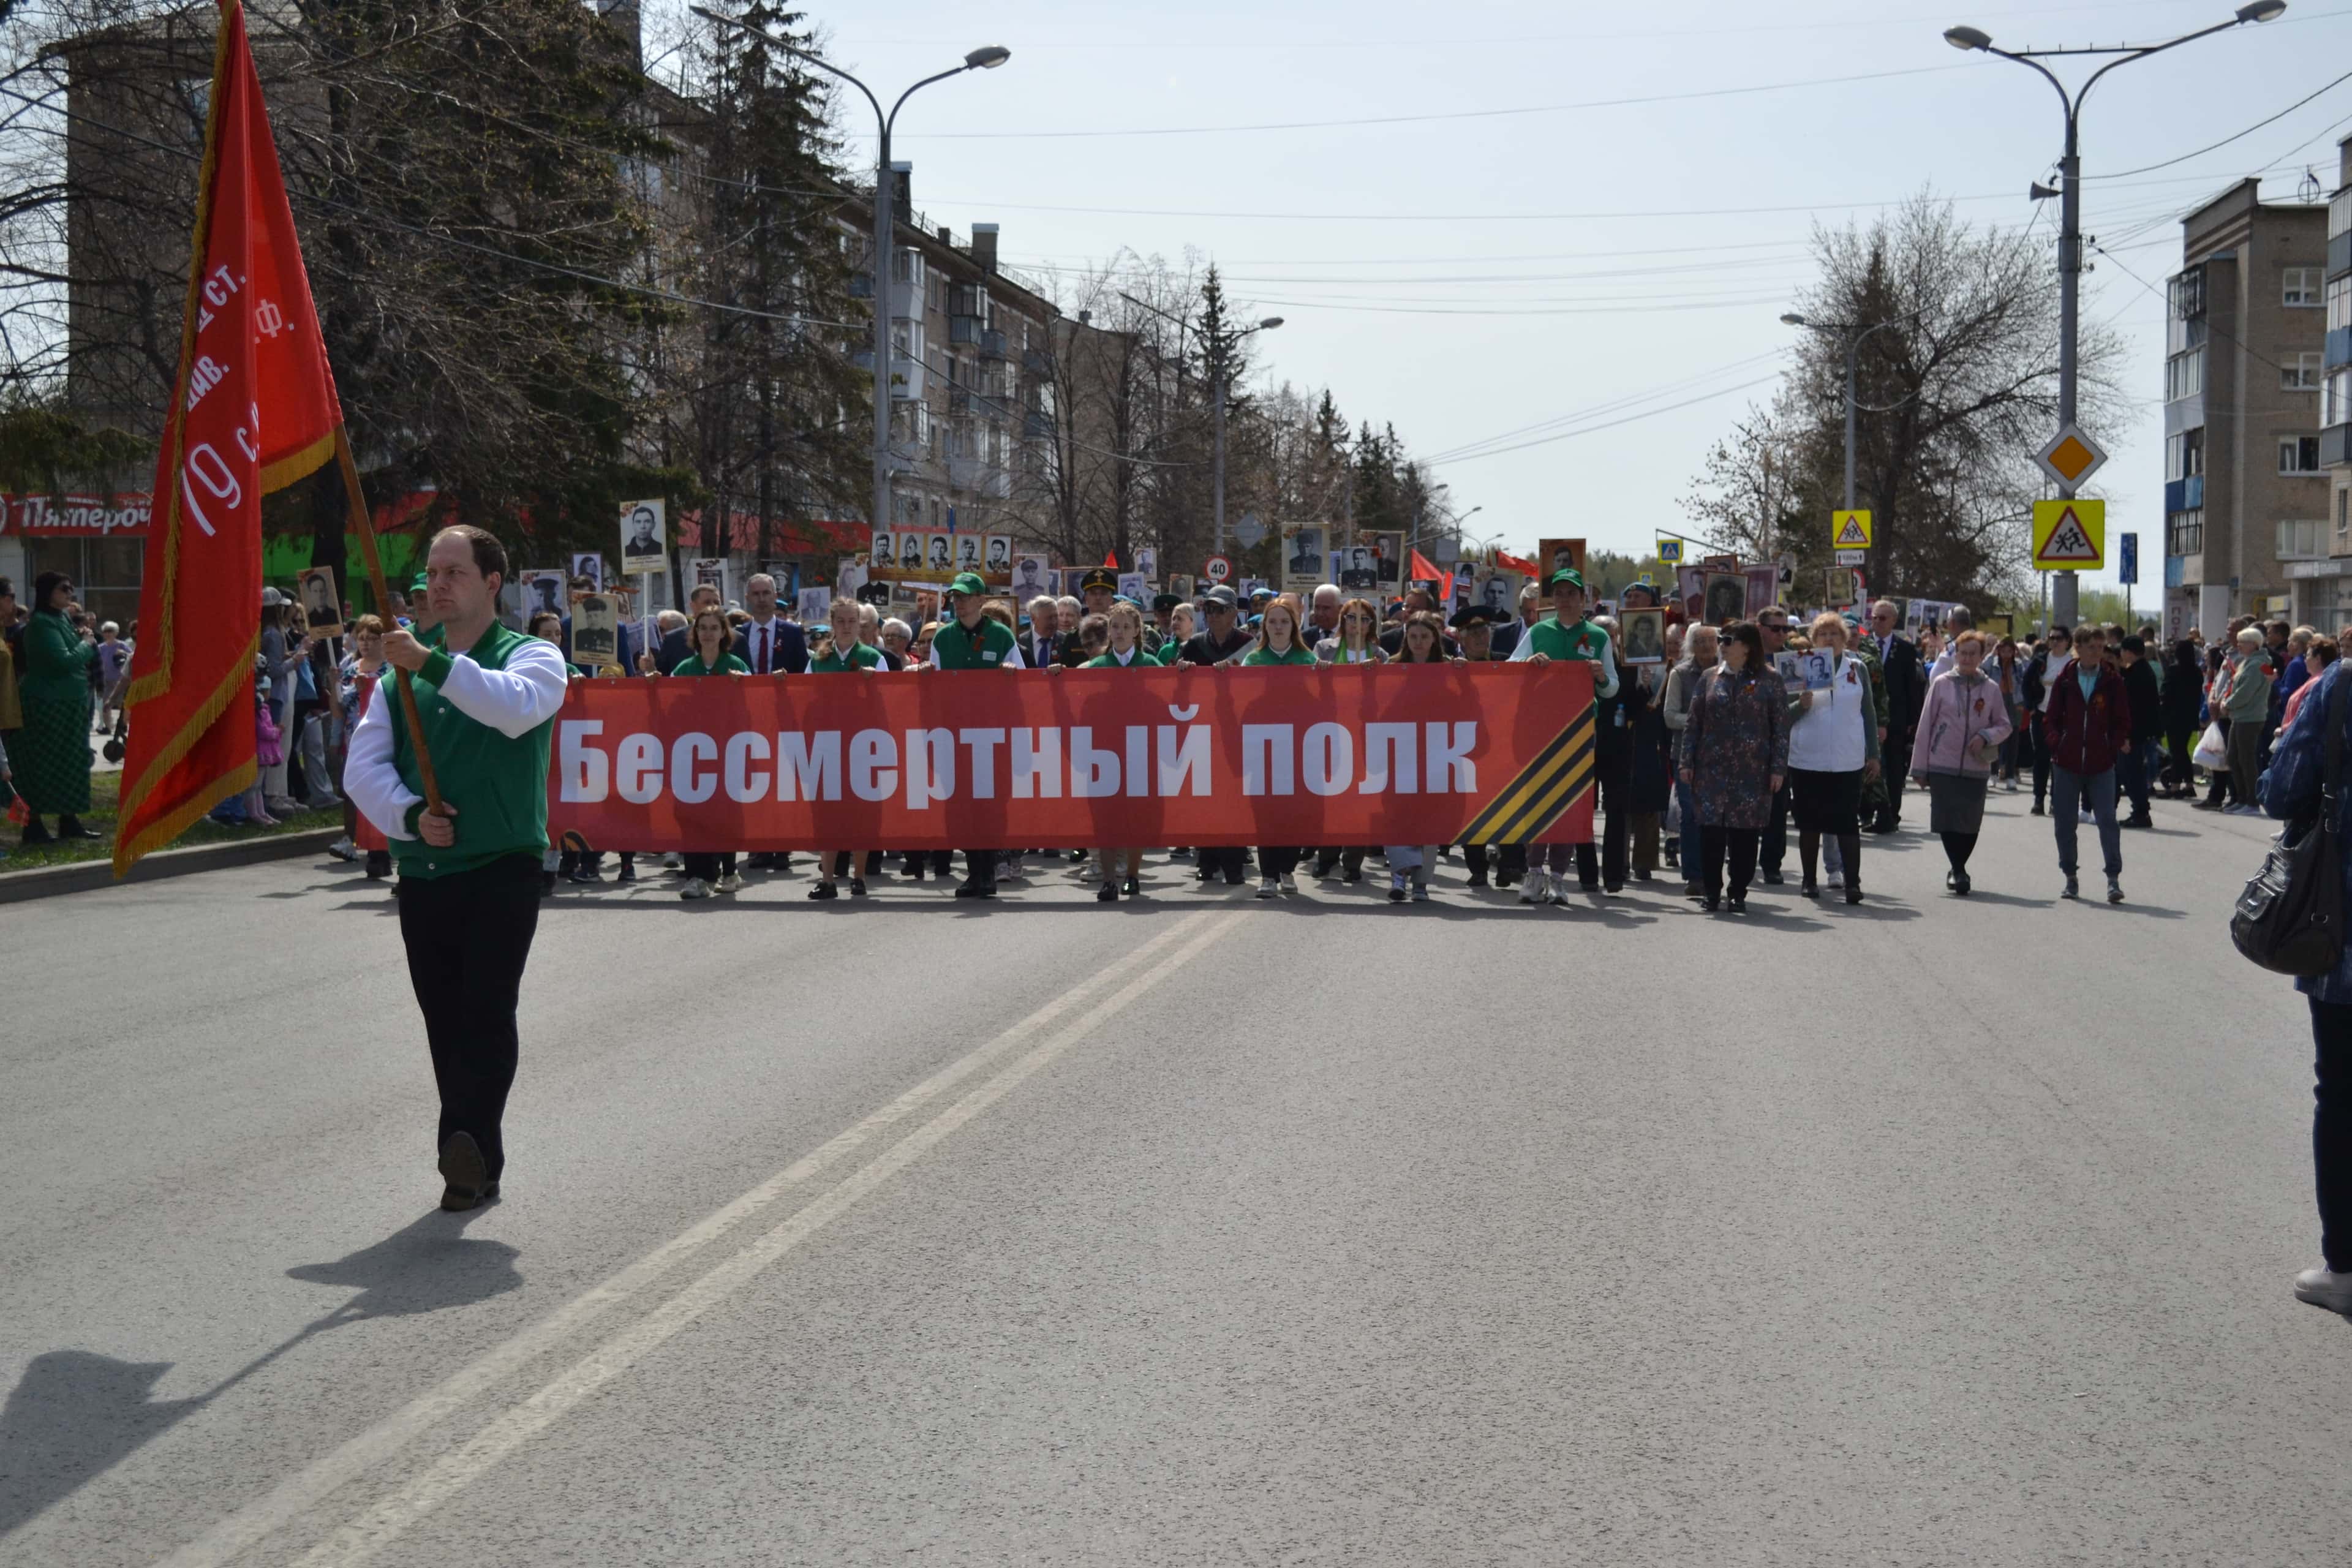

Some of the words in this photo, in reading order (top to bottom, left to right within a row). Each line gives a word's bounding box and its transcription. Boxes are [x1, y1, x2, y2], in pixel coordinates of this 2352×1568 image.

[1211, 564, 1226, 575] 40
[559, 704, 1212, 810] Бессмертный
[1242, 721, 1478, 796] полк
